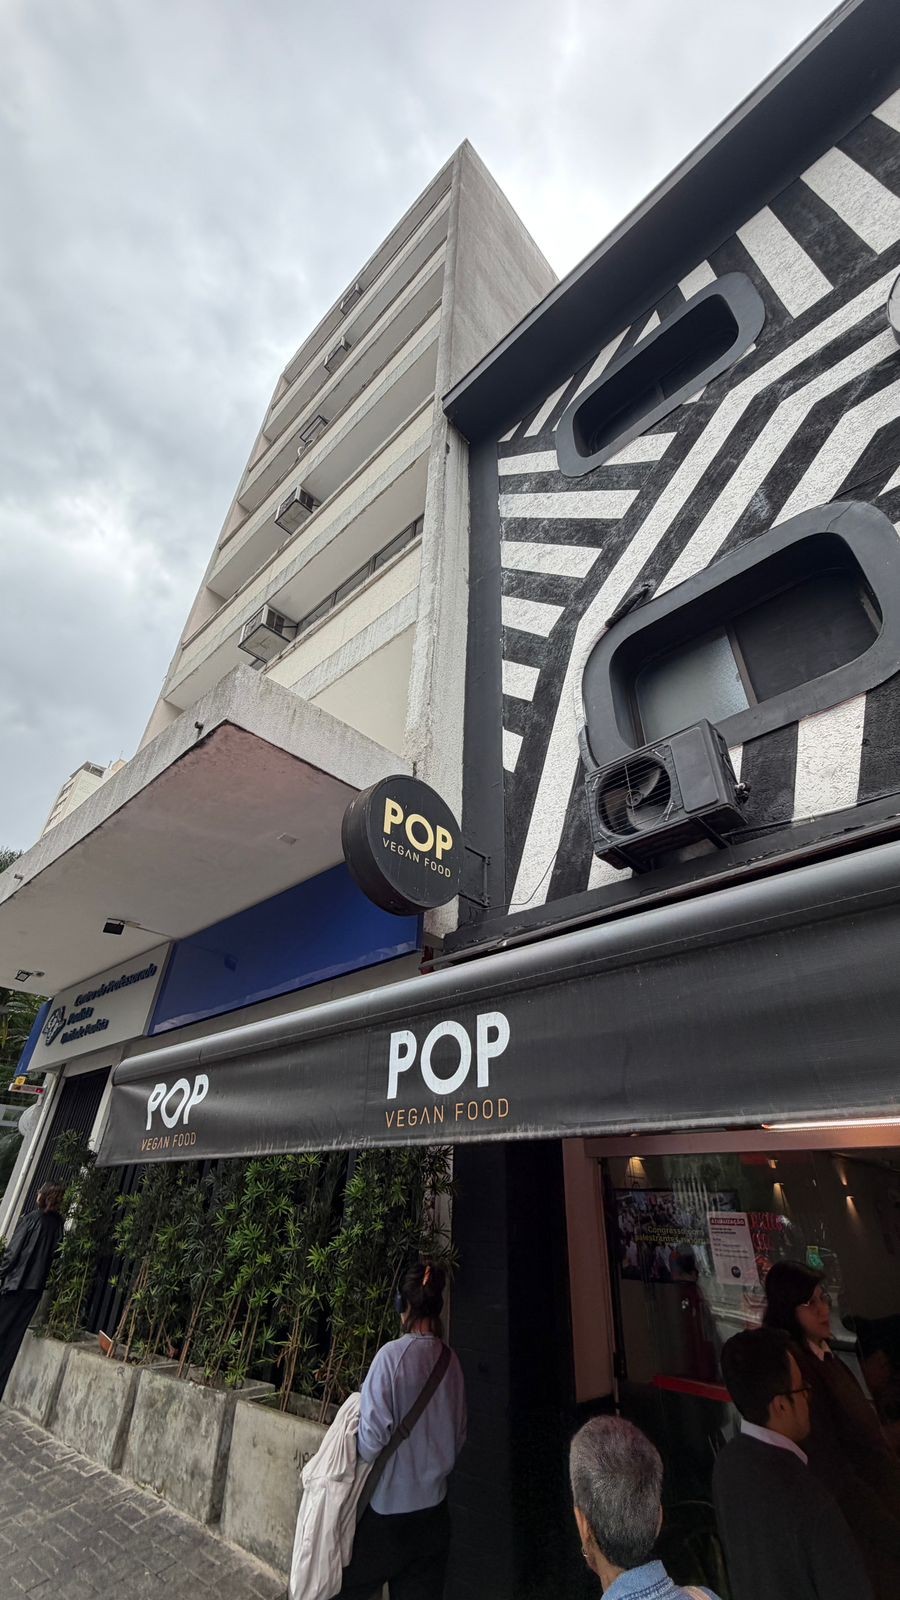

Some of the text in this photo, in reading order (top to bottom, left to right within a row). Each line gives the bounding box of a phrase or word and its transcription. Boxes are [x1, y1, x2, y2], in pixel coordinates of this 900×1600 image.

[383, 797, 453, 860] POP
[382, 837, 451, 878] VEGAN FOOD
[386, 1011, 510, 1100] POP
[146, 1074, 209, 1131] POP
[385, 1098, 509, 1128] VEGAN FOOD
[141, 1132, 197, 1151] VEGAN FOOD
